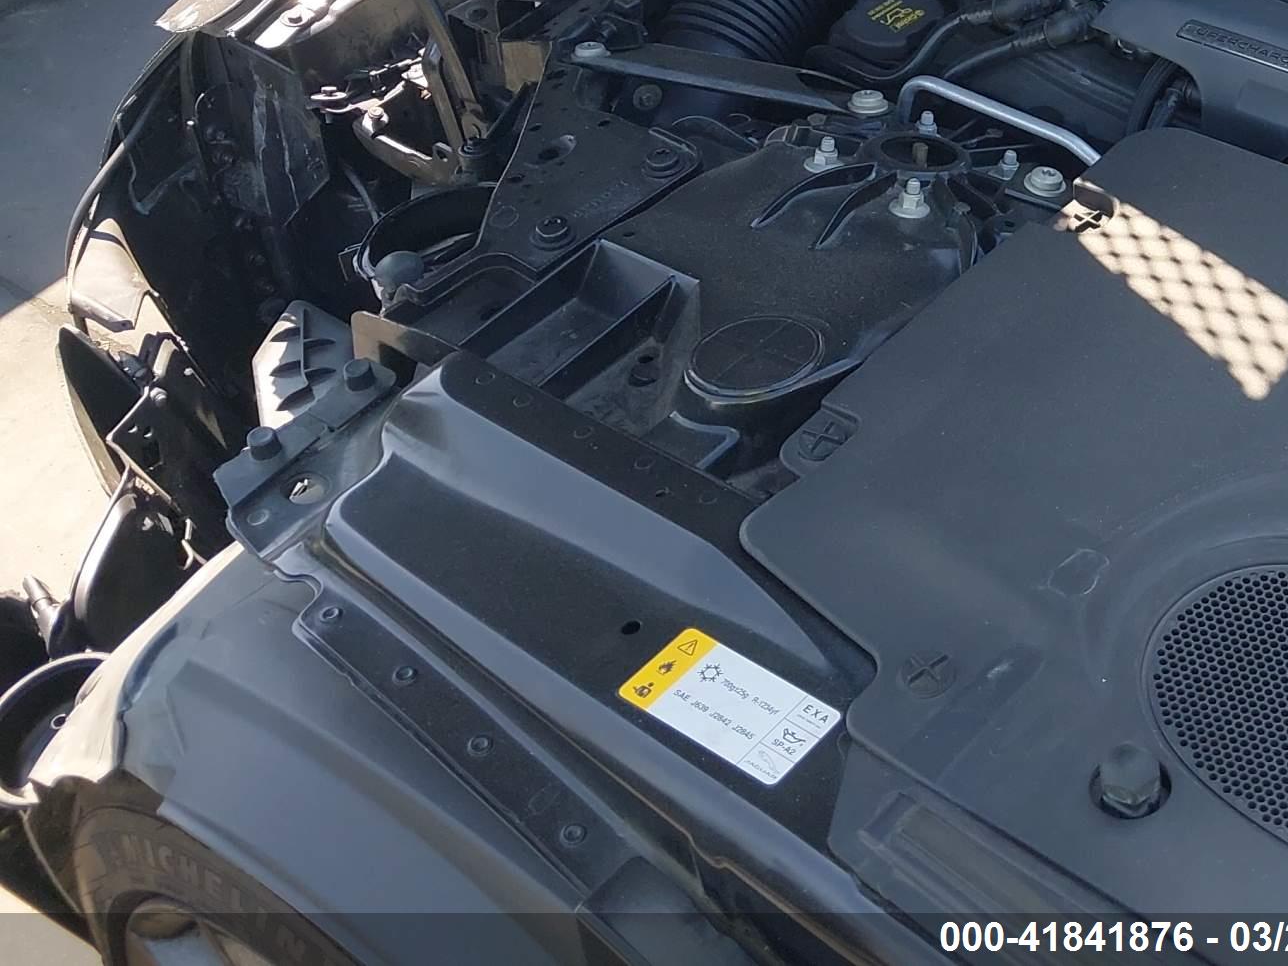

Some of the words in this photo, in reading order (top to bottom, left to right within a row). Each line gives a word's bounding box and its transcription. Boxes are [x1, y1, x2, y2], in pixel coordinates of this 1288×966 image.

[673, 689, 691, 703] SAE
[690, 697, 709, 714] J639
[802, 704, 830, 724] EXA
[771, 738, 798, 757] SP-A2
